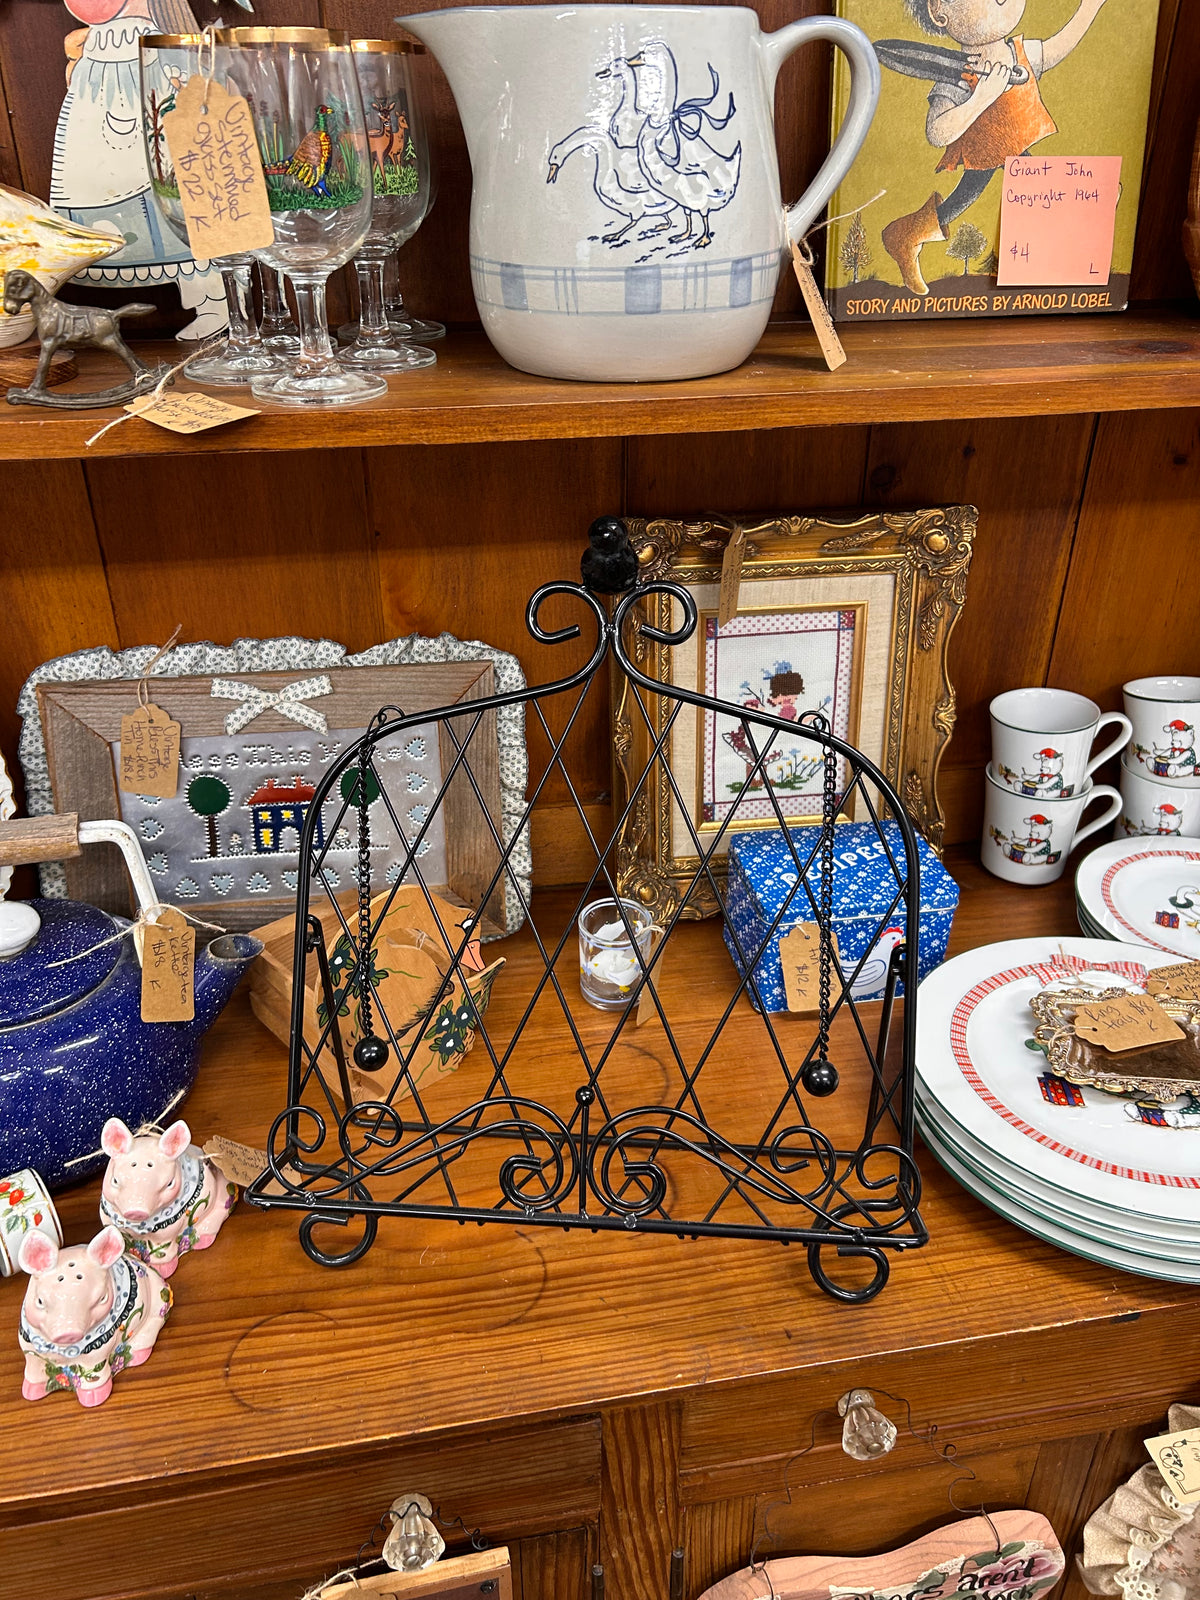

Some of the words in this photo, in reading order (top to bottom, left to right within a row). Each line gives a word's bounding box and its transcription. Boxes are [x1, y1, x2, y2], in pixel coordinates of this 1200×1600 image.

[225, 101, 255, 193] Vintage
[178, 149, 204, 202] $22
[214, 119, 250, 221] Stemmed
[1009, 159, 1053, 177] Giant
[1066, 162, 1093, 178] John
[1007, 188, 1066, 209] Copyright
[1075, 188, 1099, 203] 1964
[189, 215, 211, 232] K
[1010, 241, 1030, 263] $4
[846, 299, 890, 315] STORY
[891, 298, 921, 314] AND
[924, 295, 988, 312] PICTURES
[992, 295, 1012, 311] BY
[1012, 293, 1068, 310] ARNOLD
[1070, 292, 1113, 308] LOBEL
[162, 725, 178, 772] Vintage
[179, 751, 239, 770] less
[243, 744, 311, 767] This
[152, 940, 167, 968] $18
[178, 931, 193, 978] Vintage
[149, 980, 161, 990] K
[795, 963, 810, 984] $12
[1127, 999, 1154, 1016] $8
[1147, 1019, 1159, 1032] K
[958, 1556, 1036, 1592] aren't
